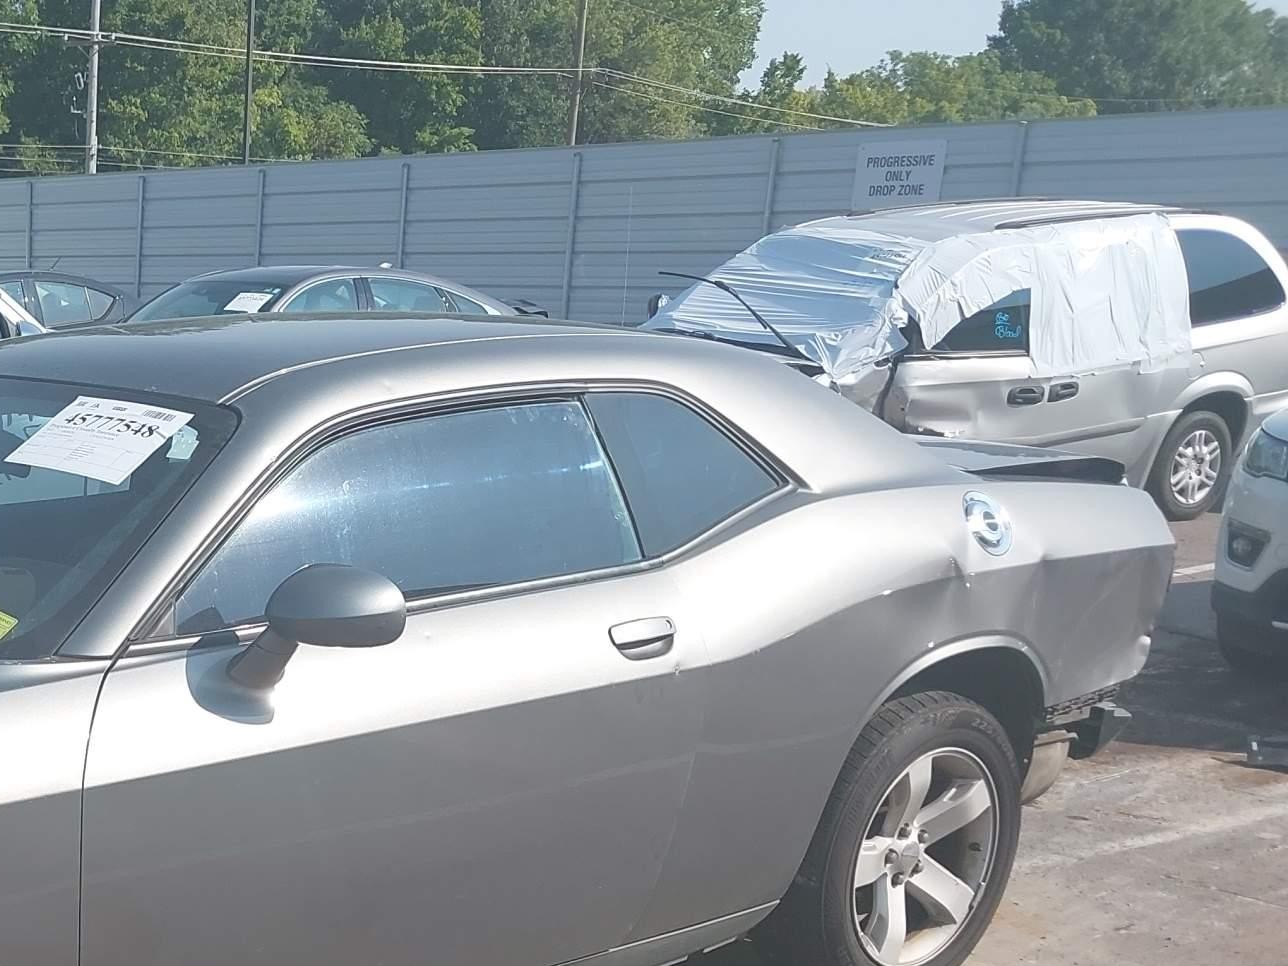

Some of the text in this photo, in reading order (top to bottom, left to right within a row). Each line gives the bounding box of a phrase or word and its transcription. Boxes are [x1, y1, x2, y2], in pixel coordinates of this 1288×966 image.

[866, 154, 936, 168] PROGRESSIVE
[885, 170, 912, 182] ONLY
[868, 184, 925, 197] DROP ZONE
[64, 412, 160, 438] 45777548
